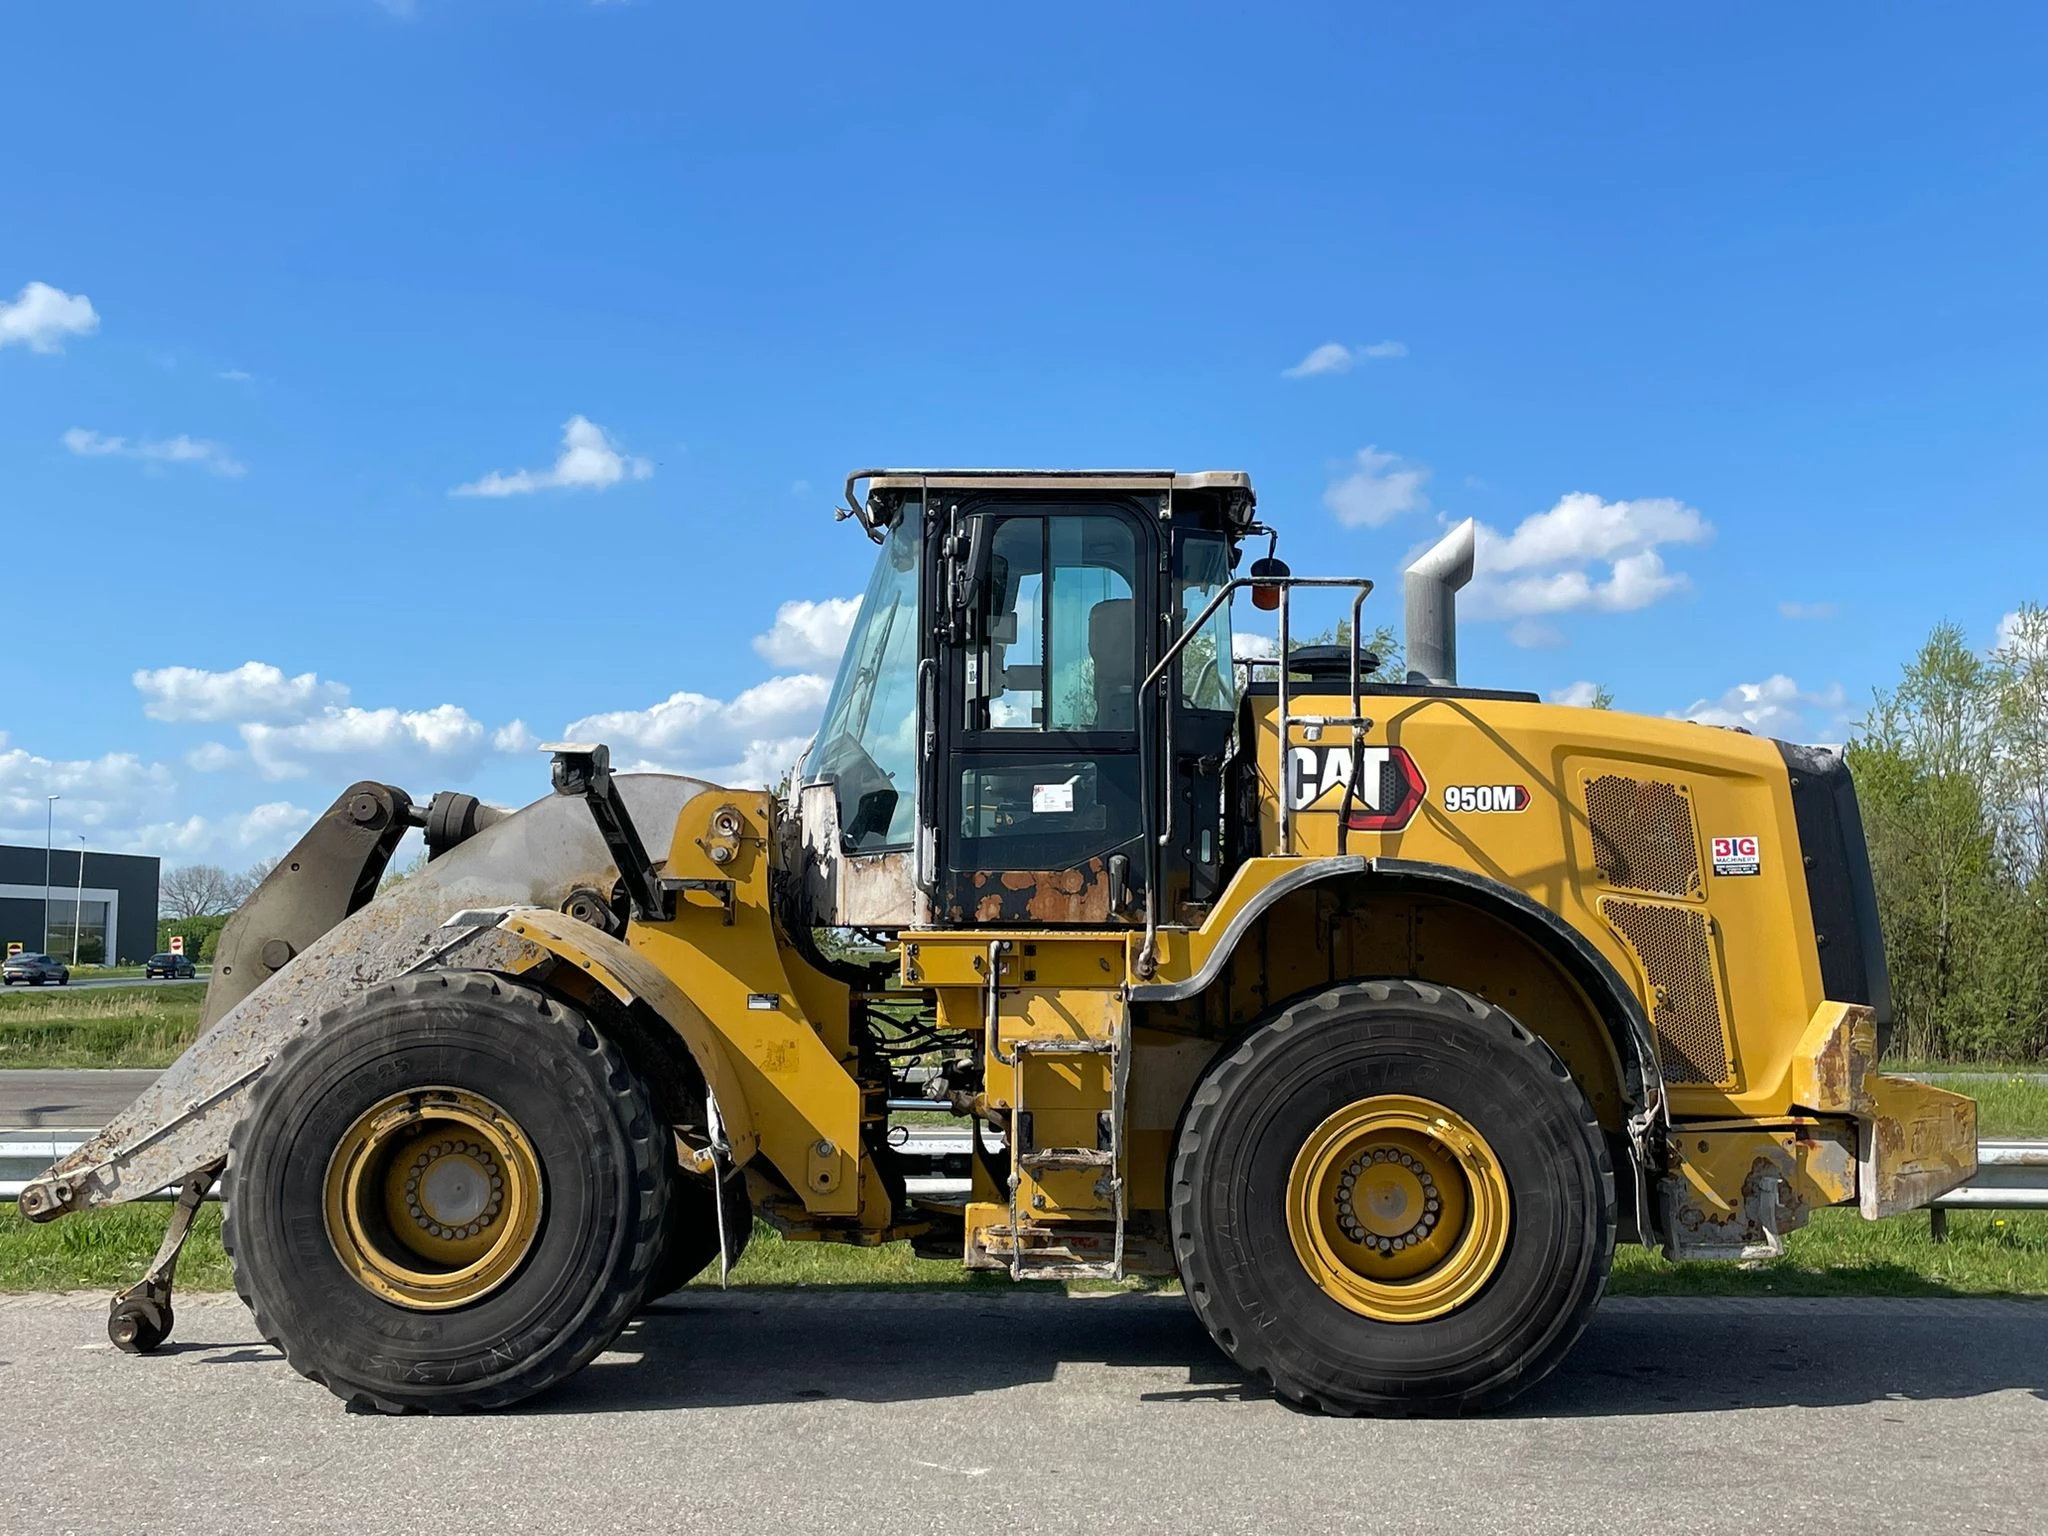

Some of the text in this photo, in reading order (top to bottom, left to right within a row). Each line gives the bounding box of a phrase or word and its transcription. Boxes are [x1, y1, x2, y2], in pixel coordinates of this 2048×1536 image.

[1288, 747, 1390, 811] CAT
[1445, 786, 1516, 811] 950M
[1715, 839, 1756, 857] BIG
